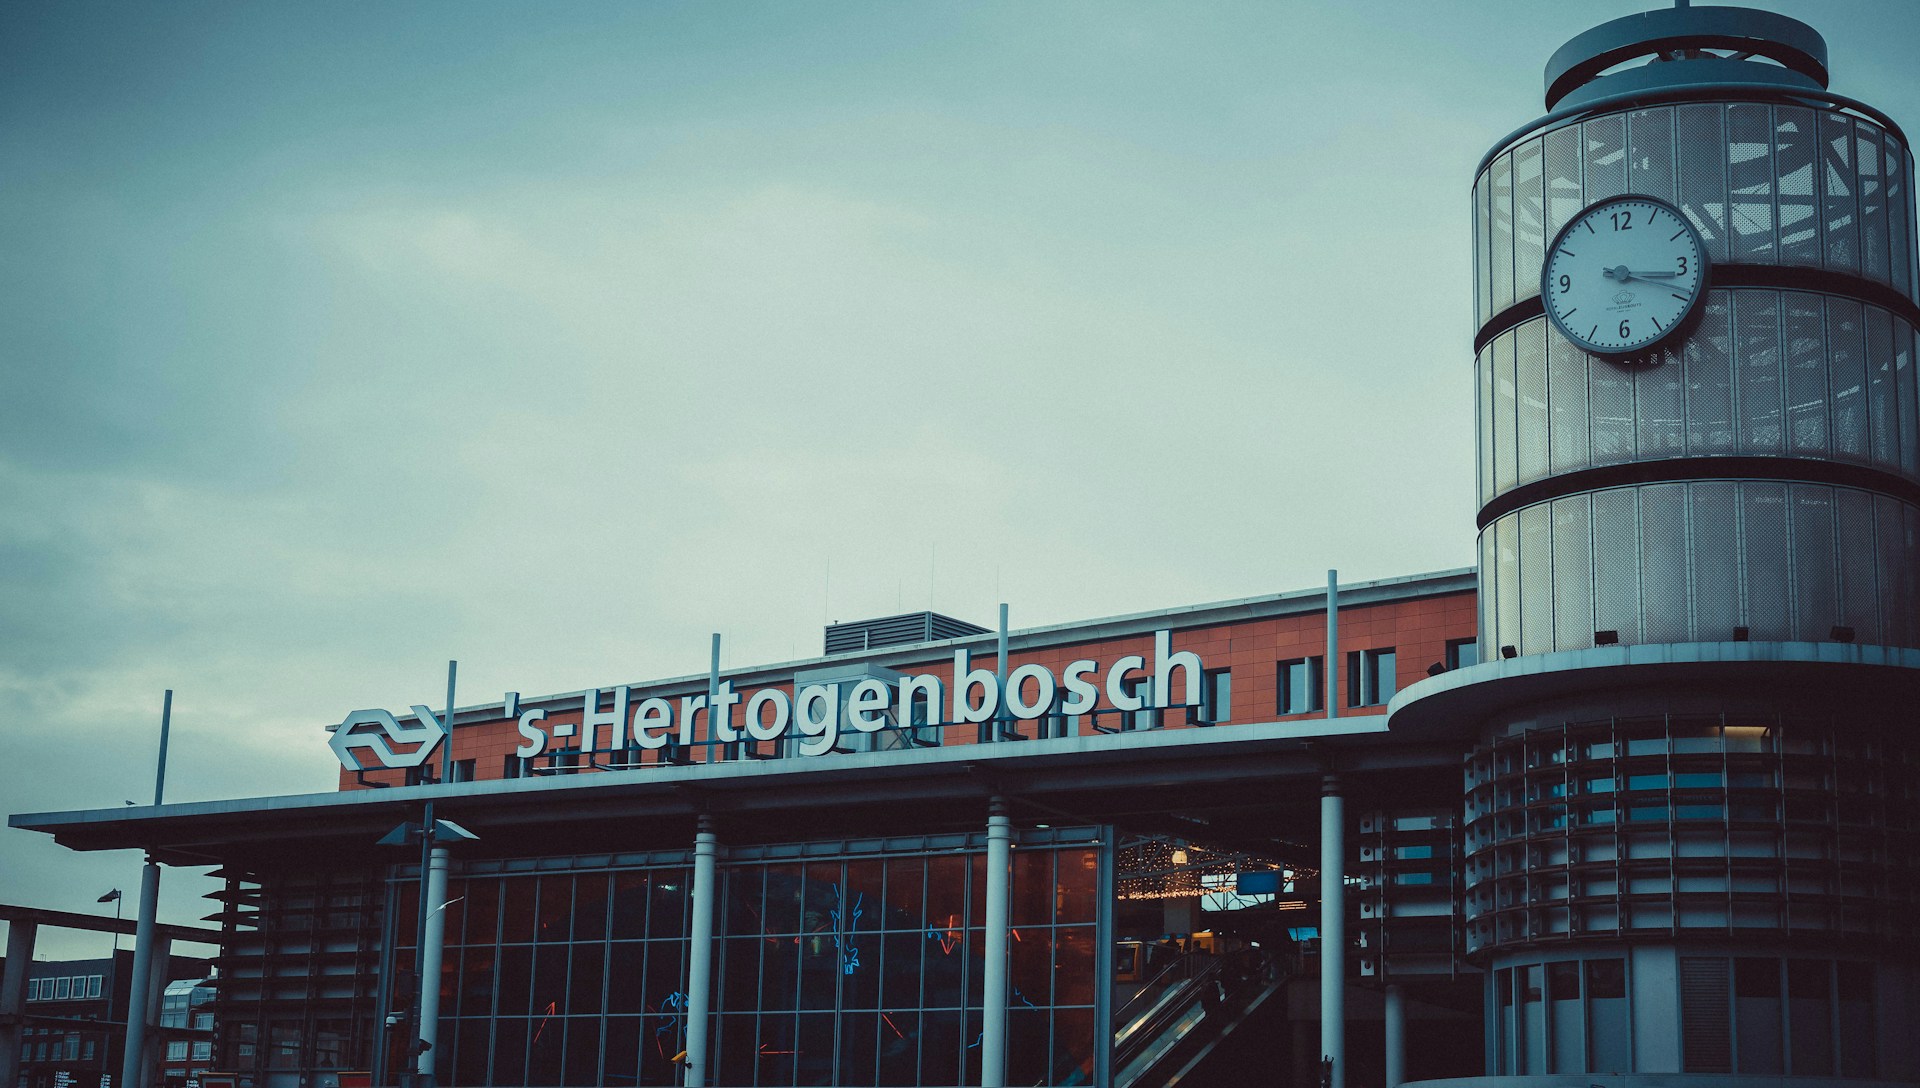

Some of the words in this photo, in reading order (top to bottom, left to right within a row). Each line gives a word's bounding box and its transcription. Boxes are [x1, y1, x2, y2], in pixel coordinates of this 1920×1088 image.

[1610, 211, 1633, 231] 12
[1676, 256, 1688, 276] 3
[1559, 274, 1571, 293] 9
[1619, 319, 1631, 339] 6
[504, 629, 1204, 759] 's-Hertogenbosch
